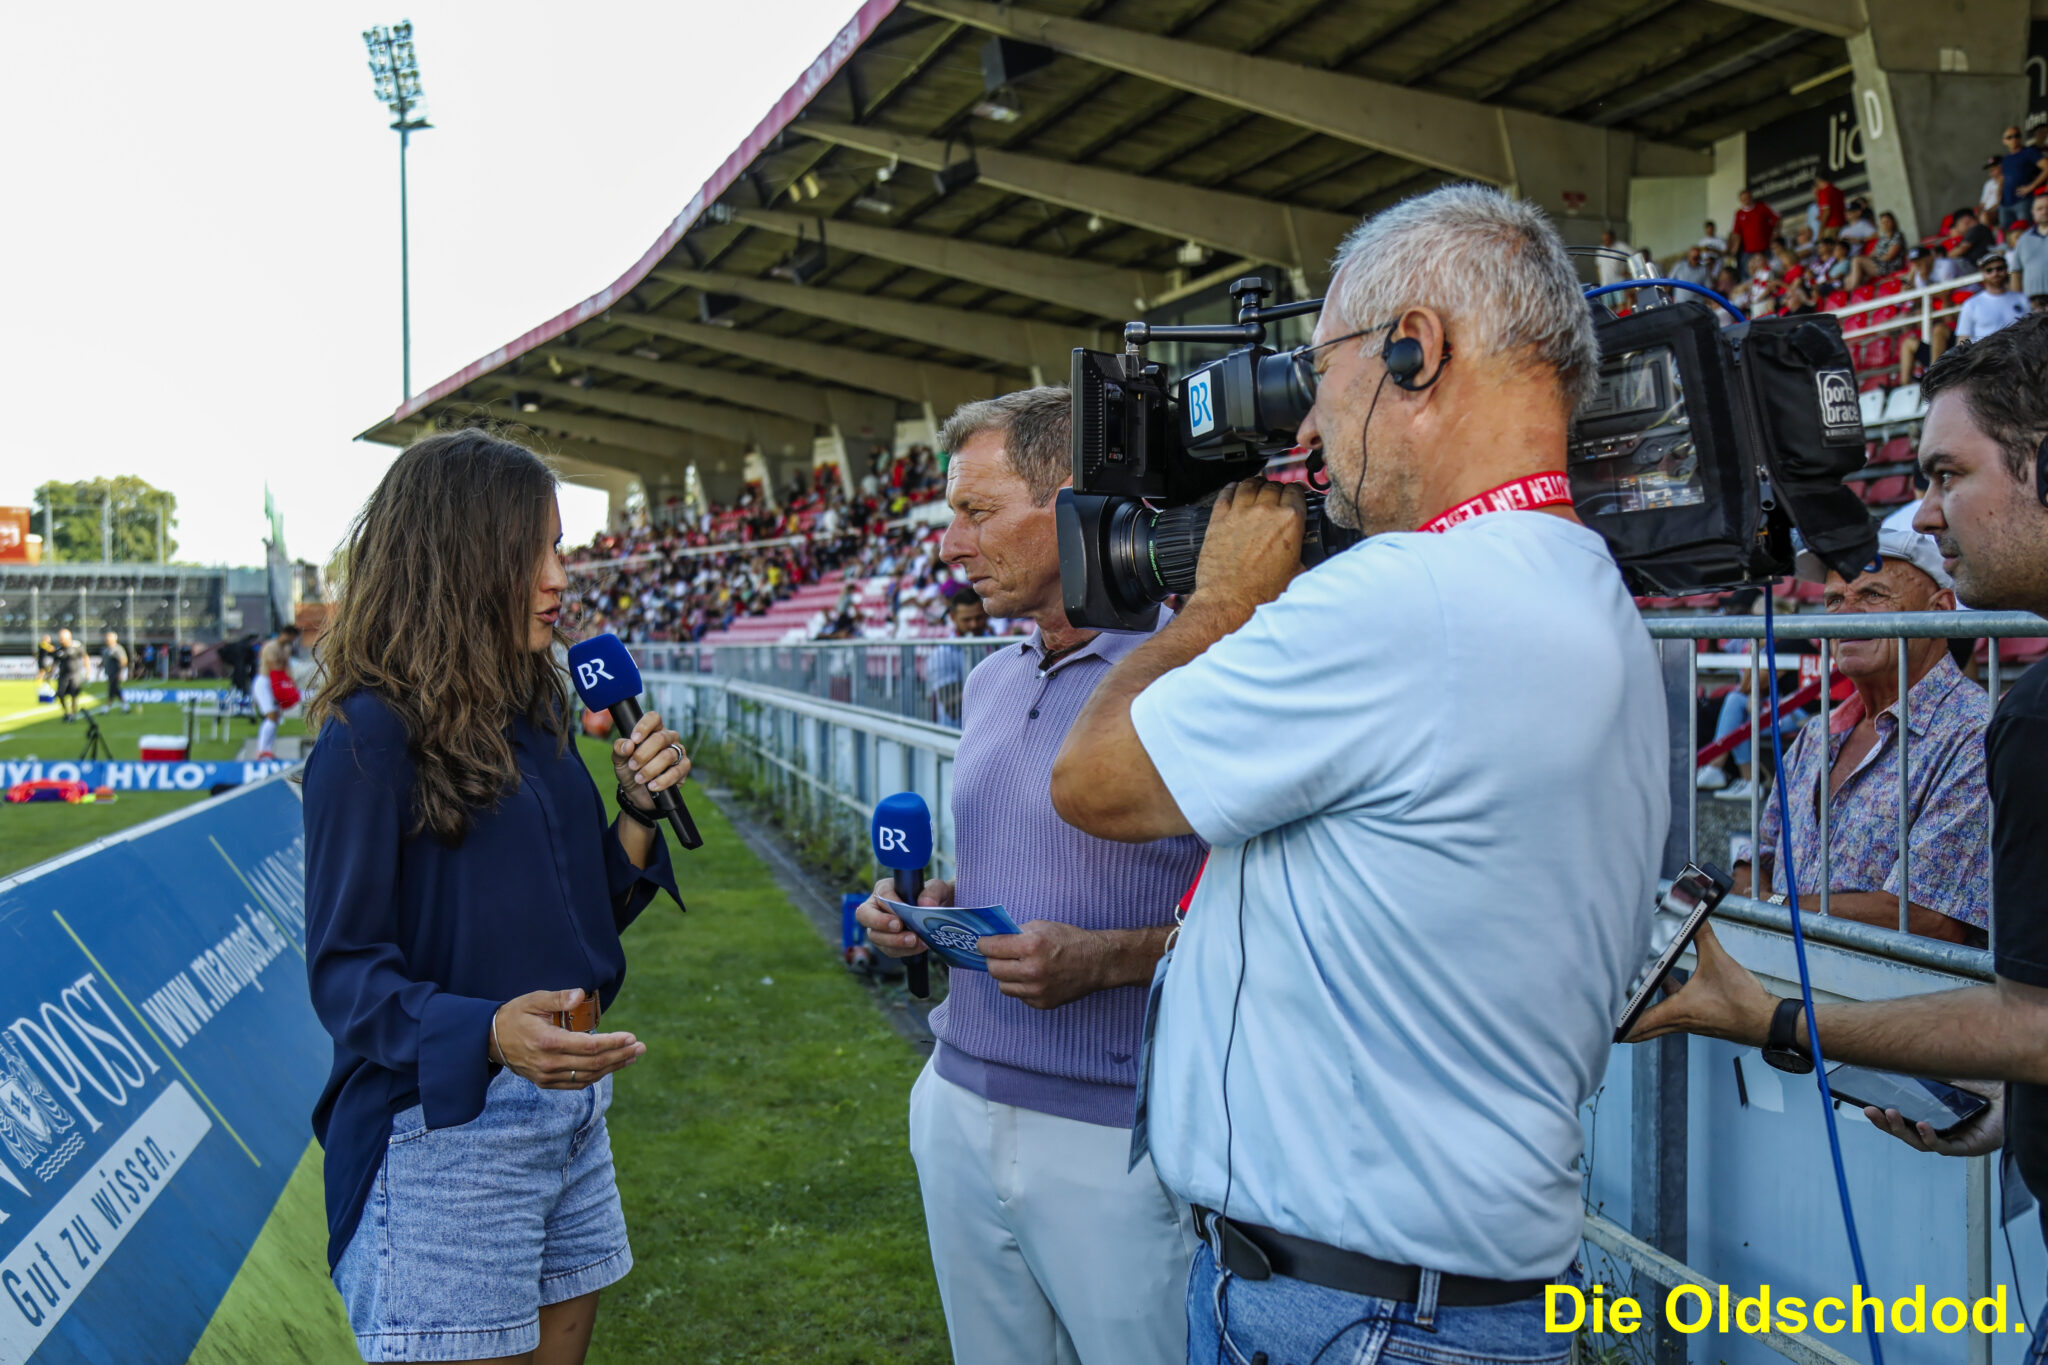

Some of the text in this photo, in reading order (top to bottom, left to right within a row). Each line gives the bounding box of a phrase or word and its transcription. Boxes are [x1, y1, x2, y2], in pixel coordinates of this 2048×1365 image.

[1190, 382, 1212, 428] BR
[1827, 405, 1859, 423] brace
[1488, 483, 1529, 511] EIN
[577, 658, 615, 690] BR
[879, 826, 910, 853] BR
[8, 973, 160, 1133] POST
[2, 1243, 70, 1327] Gut
[59, 1214, 102, 1270] zu
[92, 1135, 176, 1230] wissen.
